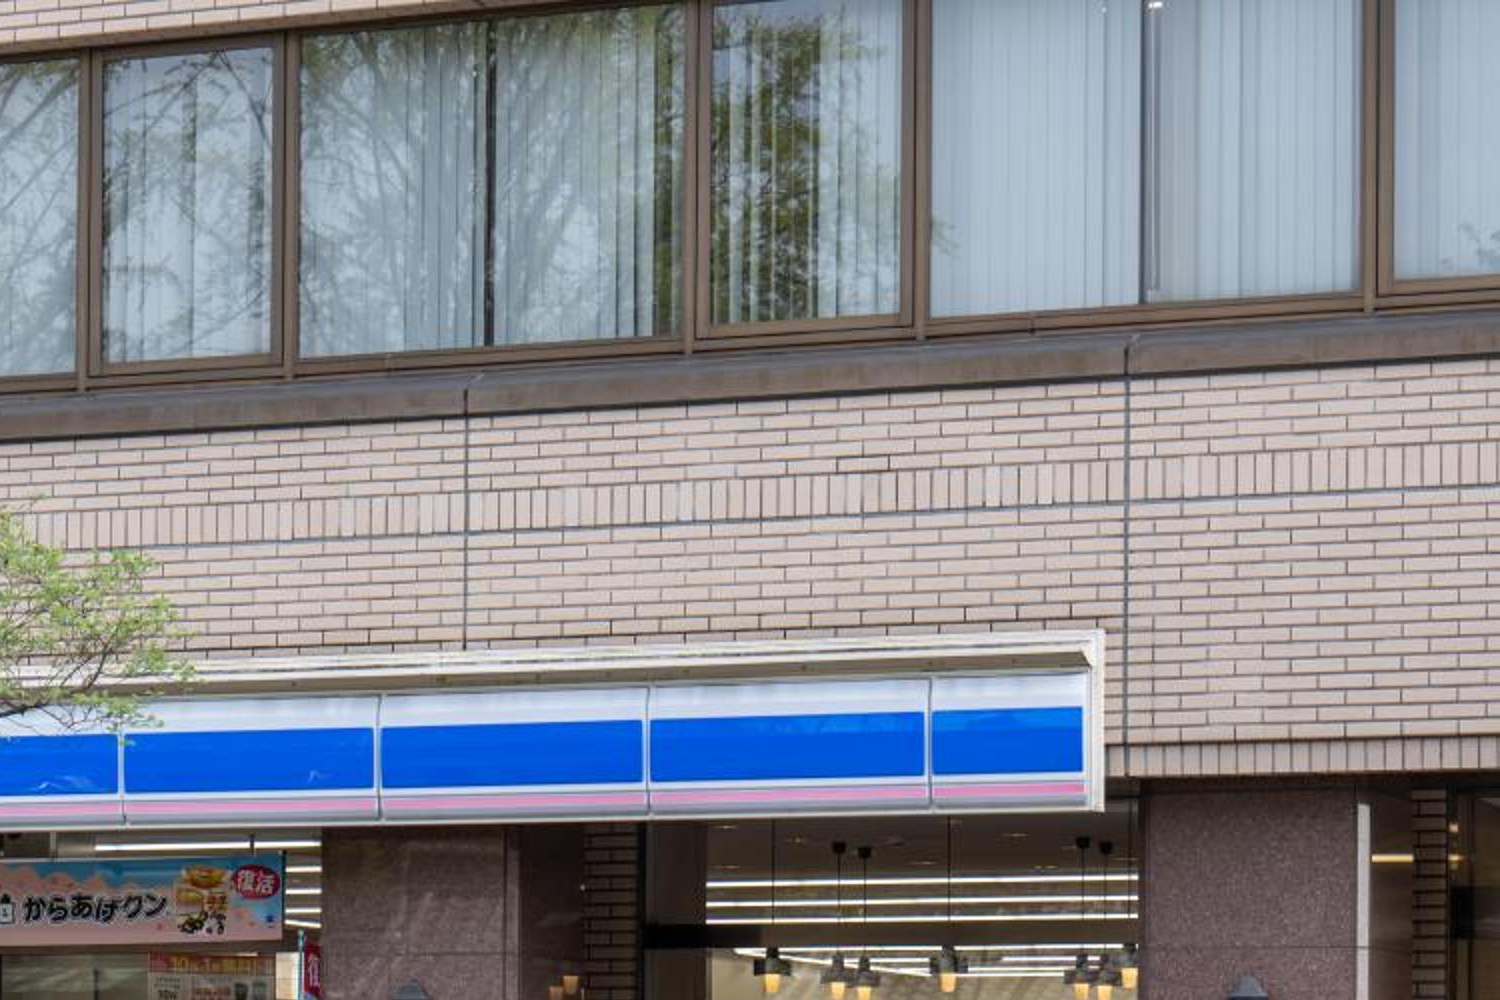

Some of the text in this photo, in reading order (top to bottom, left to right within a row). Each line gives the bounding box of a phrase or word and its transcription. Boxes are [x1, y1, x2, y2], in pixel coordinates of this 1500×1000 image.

[24, 894, 168, 923] からあげクン
